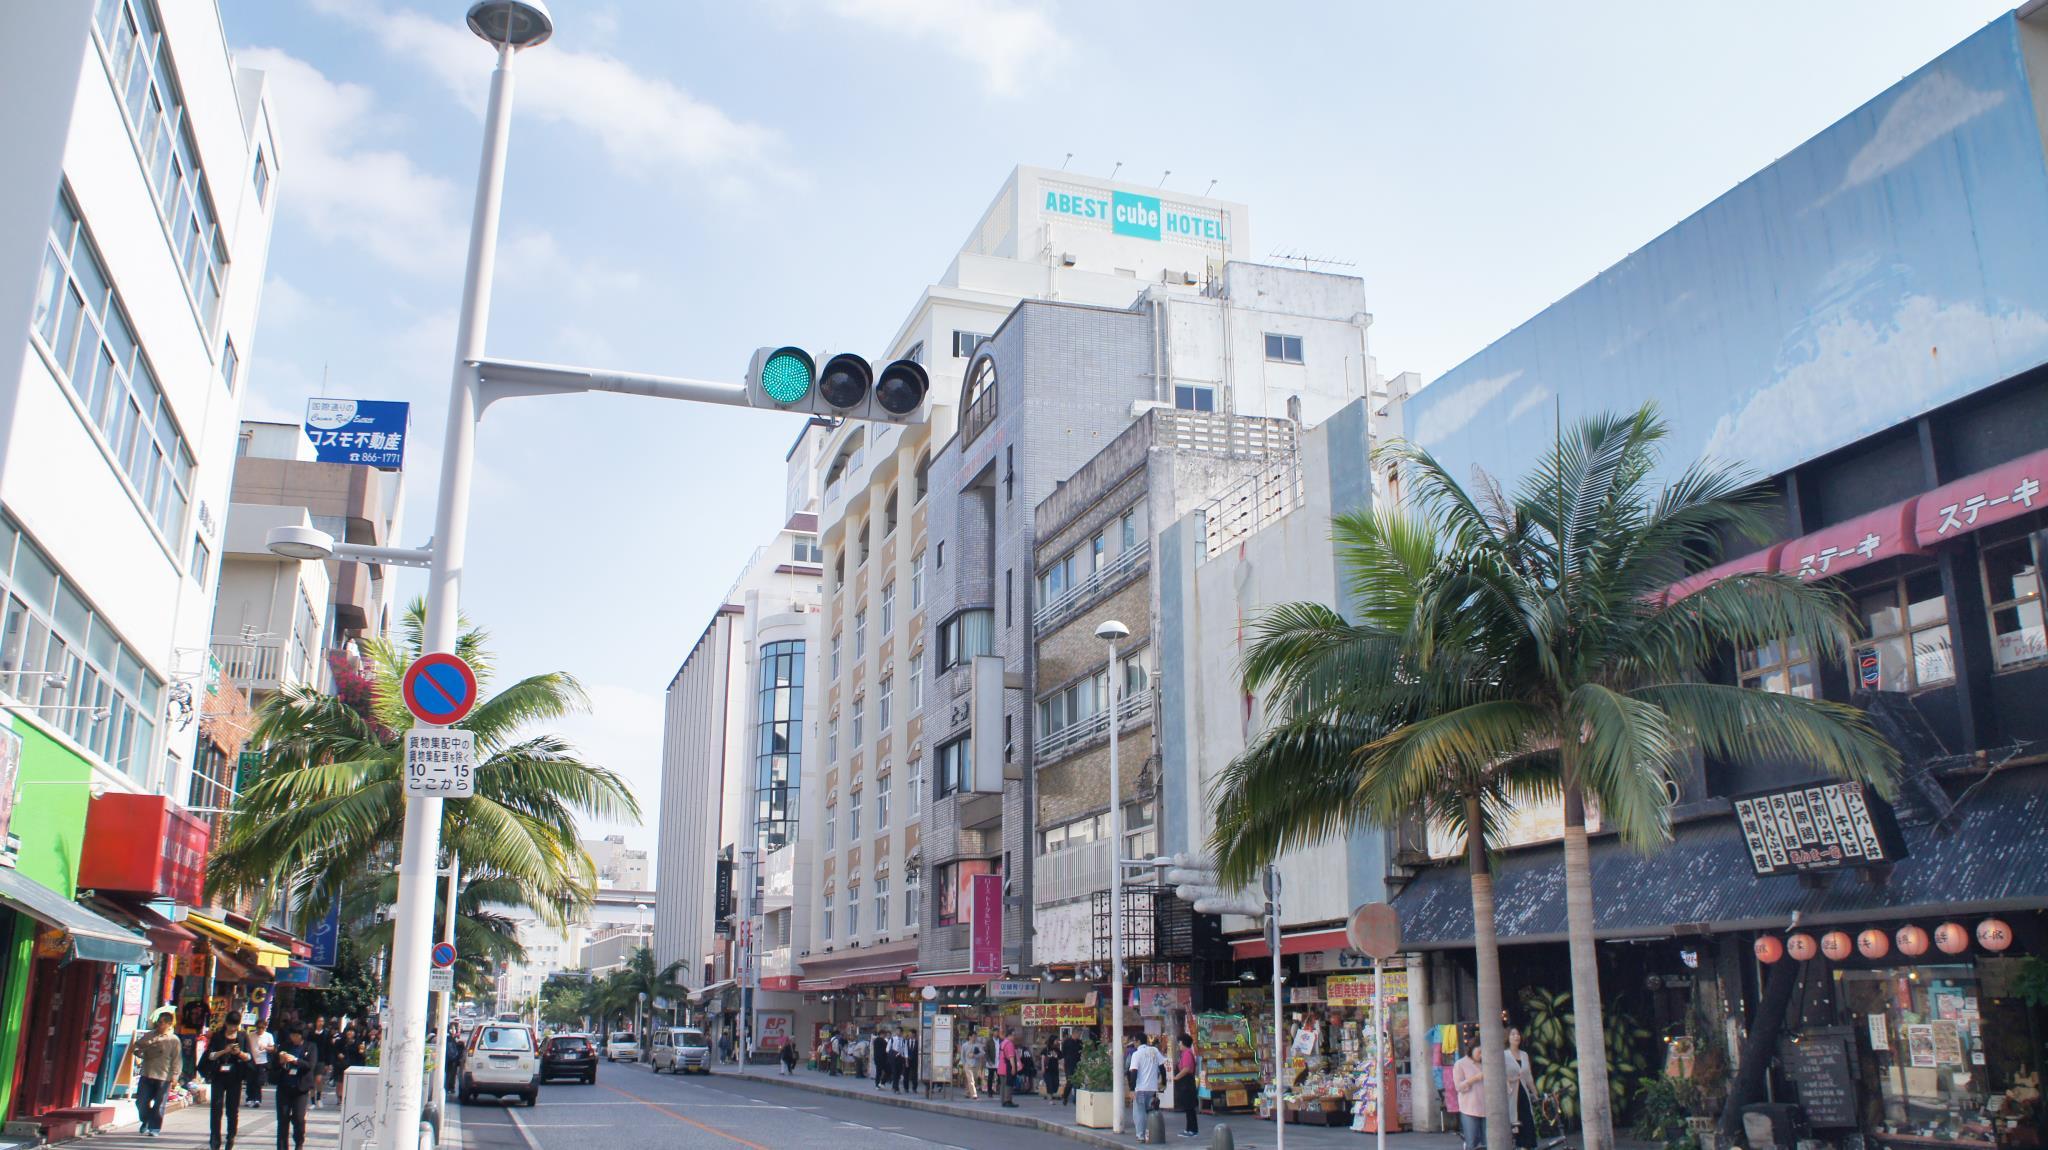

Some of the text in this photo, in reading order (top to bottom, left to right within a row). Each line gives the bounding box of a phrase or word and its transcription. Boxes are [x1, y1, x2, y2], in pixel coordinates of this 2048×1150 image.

[1045, 191, 1227, 240] ABEST cube HOTEL
[309, 430, 402, 451] コスモ不動産
[361, 452, 400, 463] 866-1771
[1937, 478, 2040, 535] ステーキ
[1798, 533, 1881, 580] ステーキ
[409, 736, 470, 750] 貨物集配中の
[409, 750, 469, 763] 貨物集配車を除く
[409, 763, 426, 777] 10
[453, 764, 469, 777] 15
[410, 778, 468, 791] ここから
[1826, 788, 1860, 855] ソーキそば
[1739, 801, 1770, 869] 沖縄料理
